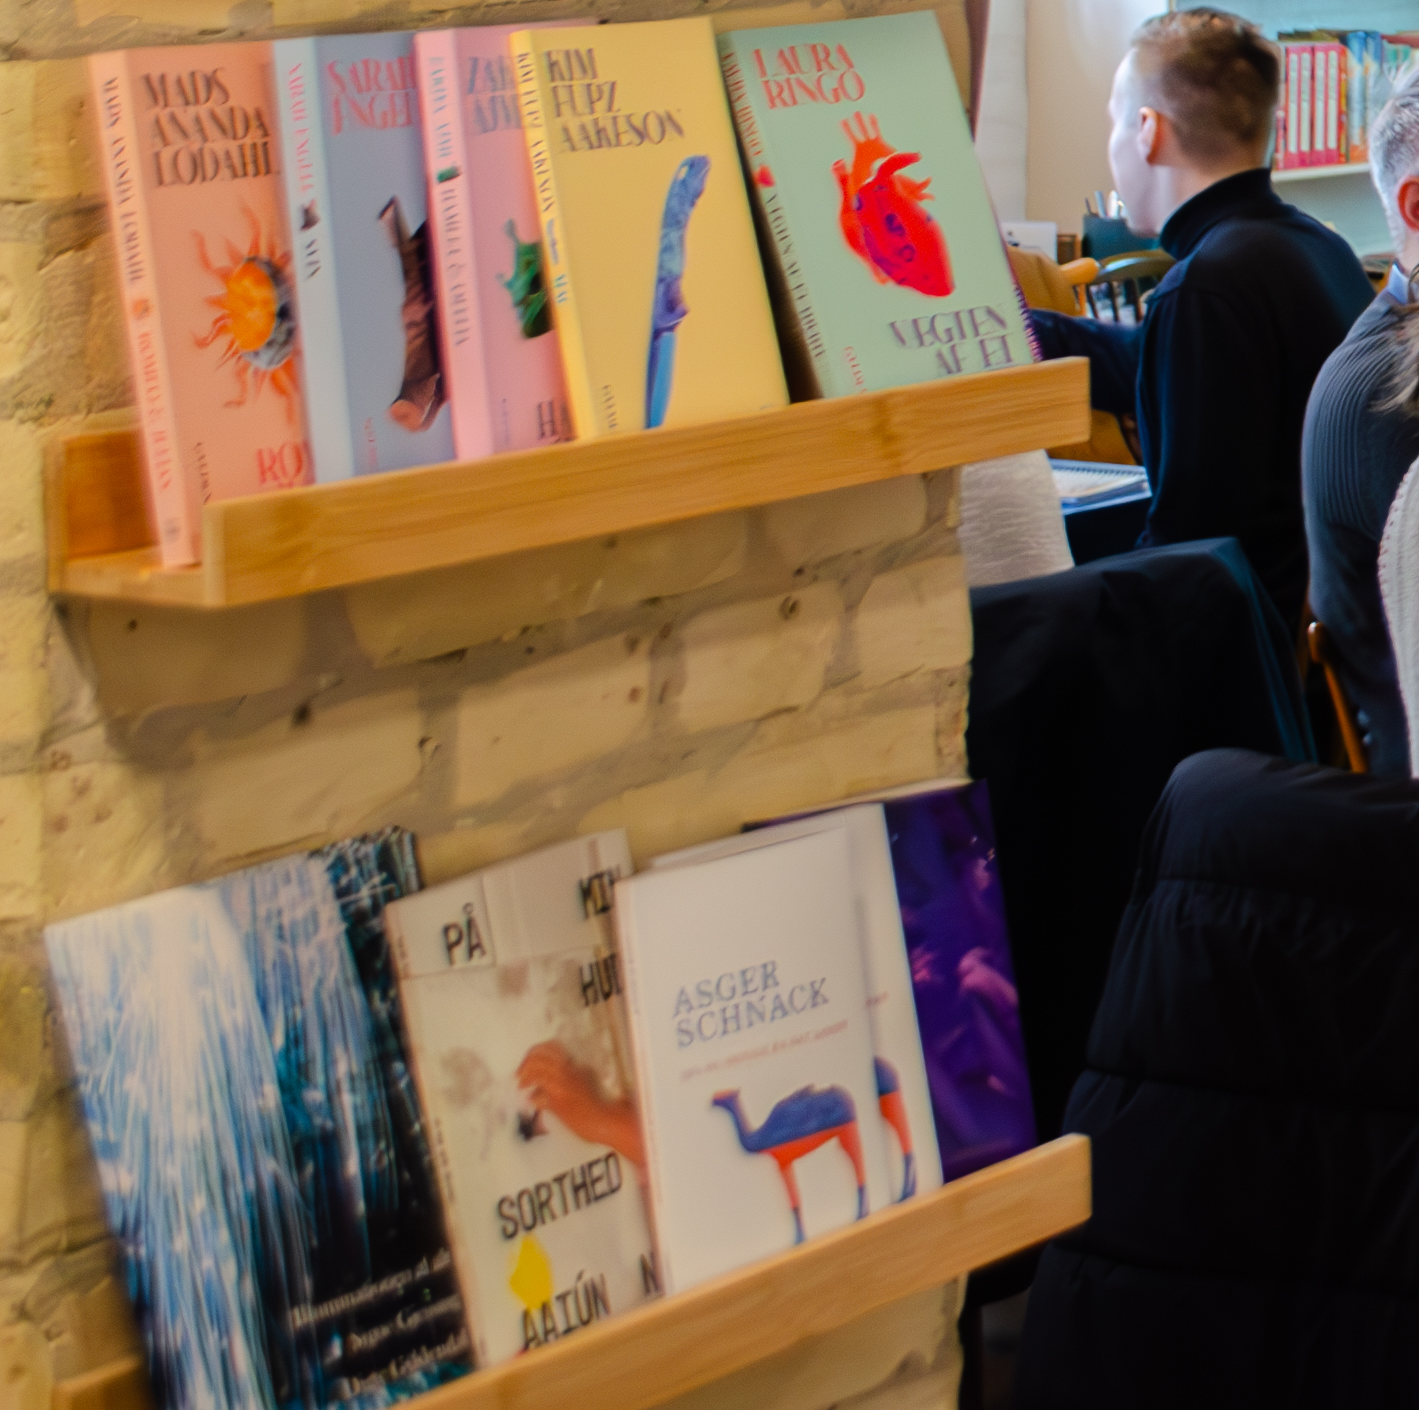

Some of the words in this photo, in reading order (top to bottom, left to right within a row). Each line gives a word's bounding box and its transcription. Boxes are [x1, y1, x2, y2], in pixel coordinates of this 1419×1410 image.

[544, 47, 598, 83] KIM
[753, 41, 856, 79] LAURA
[140, 66, 230, 108] MADS
[549, 79, 620, 119] FUPZ
[761, 70, 866, 110] RINGO
[147, 104, 271, 150] ANANDA
[558, 107, 687, 154] AAKESON
[154, 141, 281, 188] LODAHL
[888, 303, 1009, 350] VEGTEN
[442, 901, 487, 967] PÅ
[672, 959, 780, 1019] ASGER
[676, 976, 830, 1050] SCHNACK
[497, 1150, 624, 1241] SORTHED
